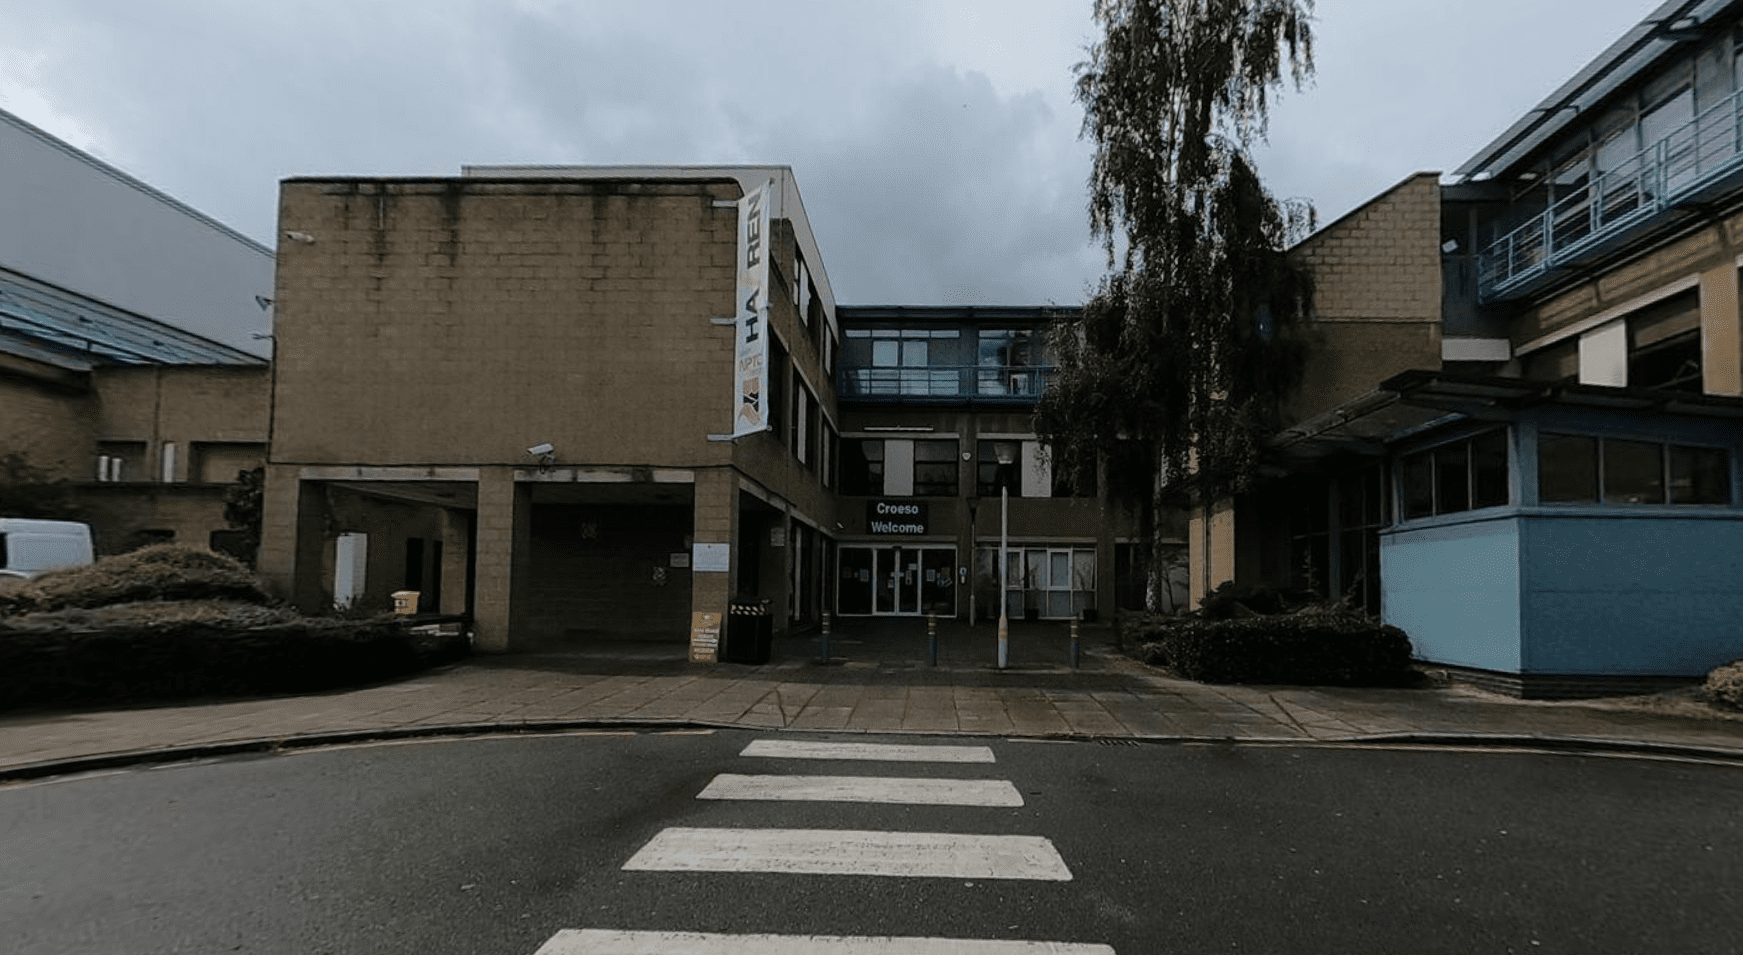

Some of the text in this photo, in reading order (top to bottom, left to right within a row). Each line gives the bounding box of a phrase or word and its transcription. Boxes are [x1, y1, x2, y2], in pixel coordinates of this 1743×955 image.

[746, 193, 761, 344] HAREN
[877, 502, 919, 515] Croeso
[871, 521, 924, 534] Welcome
